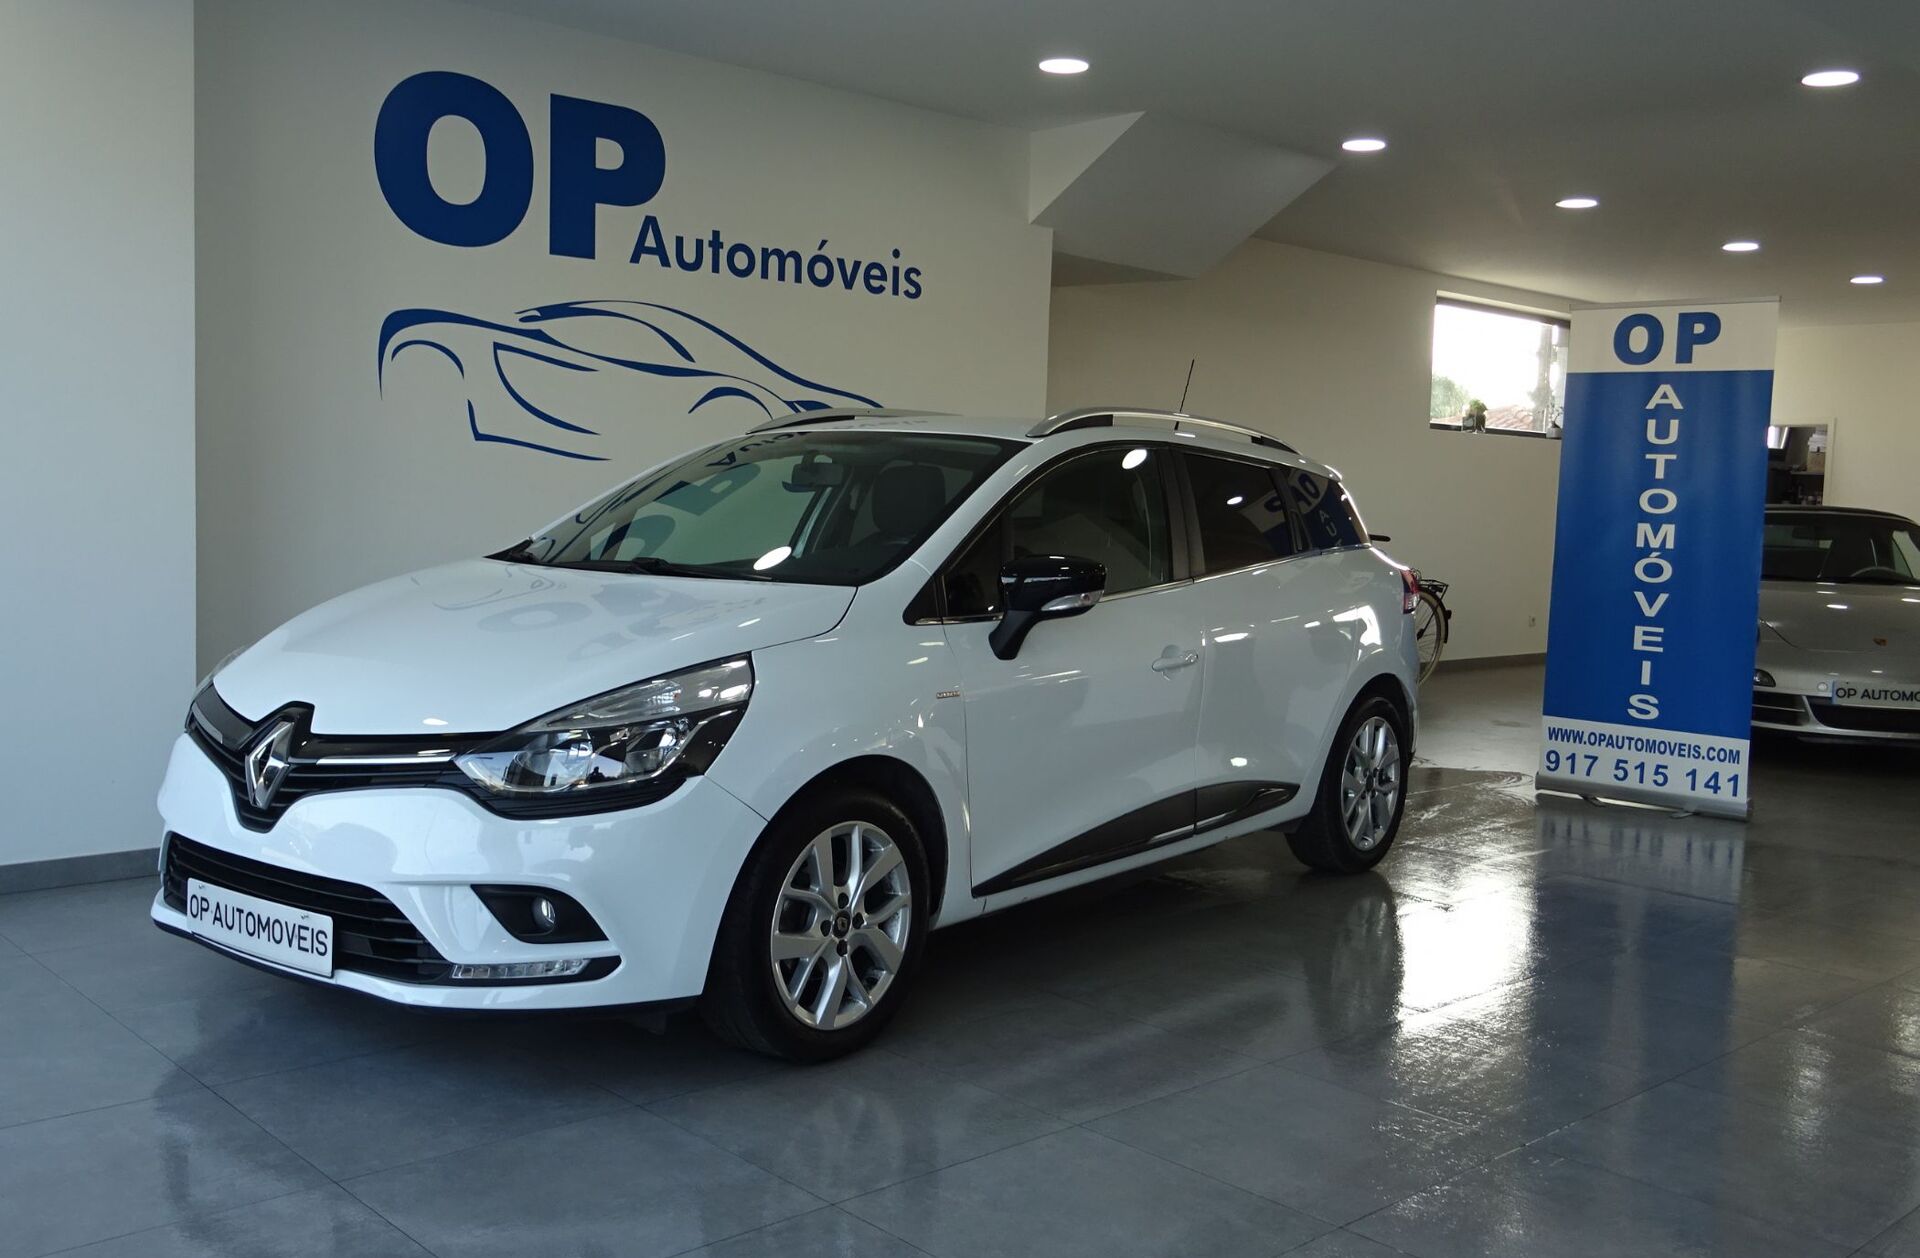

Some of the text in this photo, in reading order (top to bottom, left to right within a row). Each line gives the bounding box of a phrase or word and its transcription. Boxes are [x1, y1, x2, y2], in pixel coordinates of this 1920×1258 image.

[373, 71, 666, 260] OP
[630, 215, 921, 299] Automóveis
[1613, 312, 1722, 366] OP
[1627, 383, 1684, 720] AUTOMÓVEIS
[1835, 687, 1858, 699] OP
[1545, 749, 1740, 797] 917 515 141
[1548, 727, 1740, 764] WWW.OPAUTOMOVEIS.COM
[189, 894, 328, 957] OP AUTOMOVEIS
